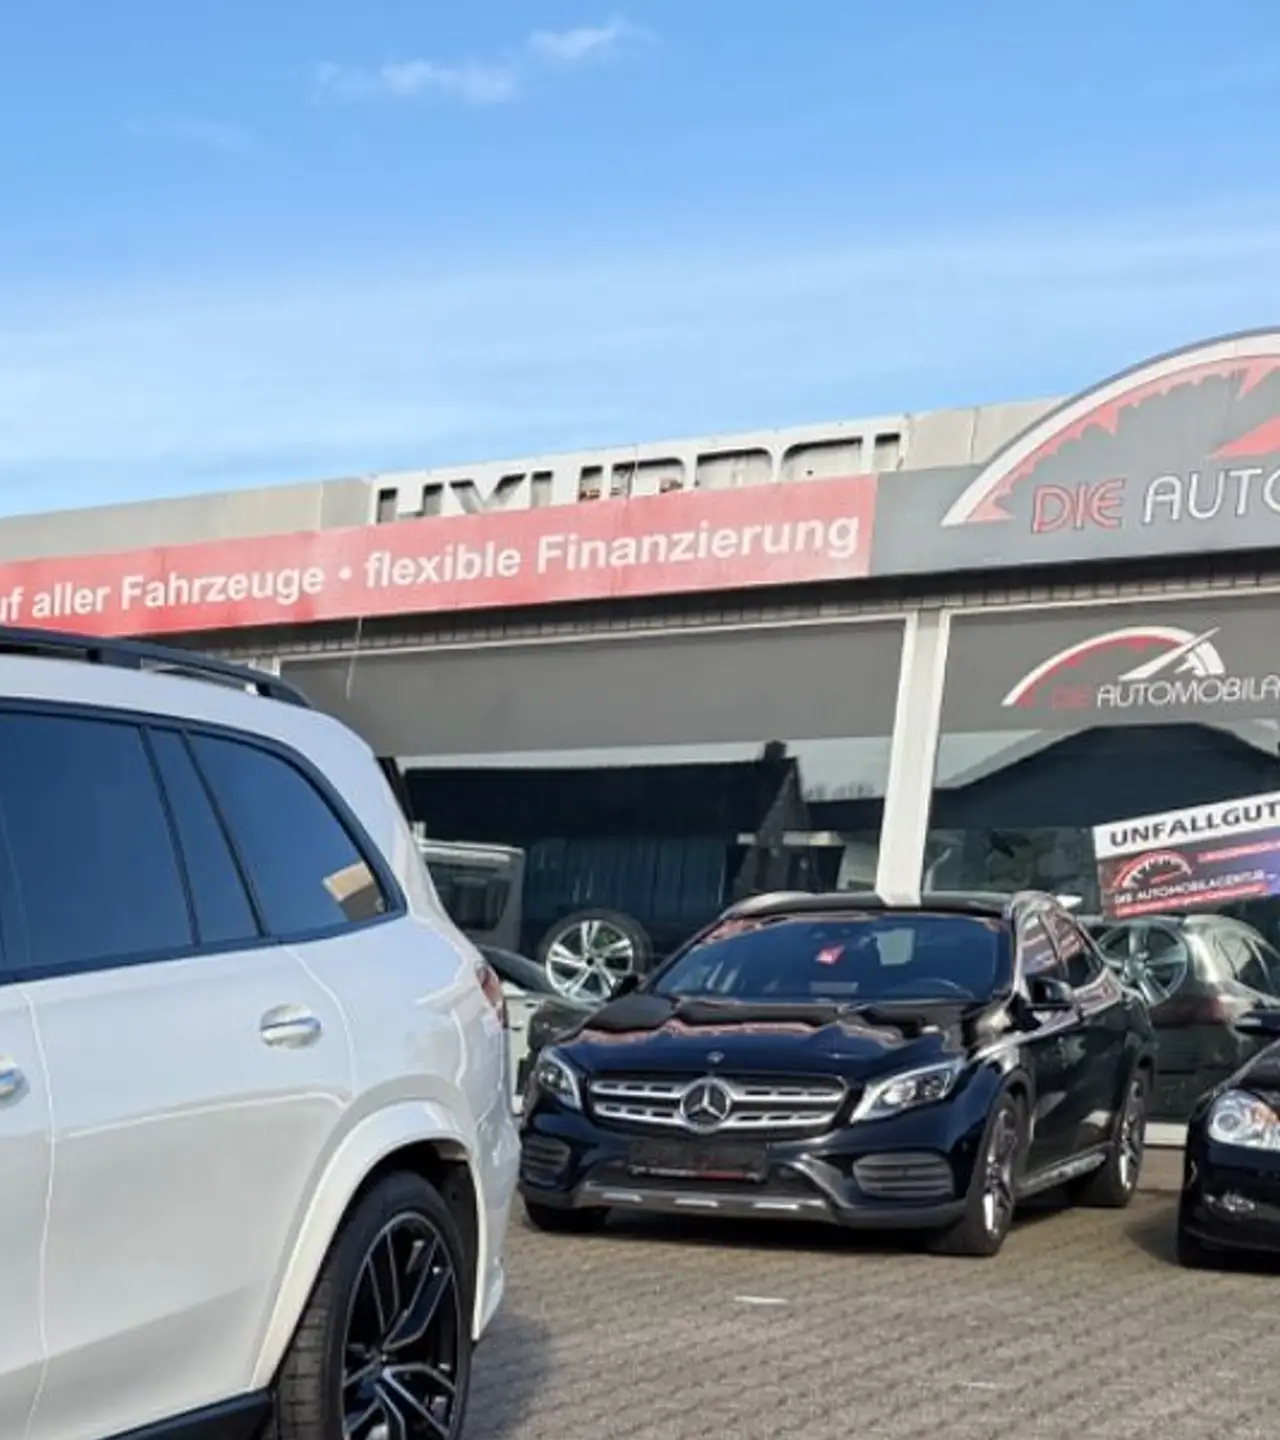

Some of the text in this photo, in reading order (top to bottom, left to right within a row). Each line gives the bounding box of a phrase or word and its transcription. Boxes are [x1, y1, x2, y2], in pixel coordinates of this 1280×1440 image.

[1031, 479, 1125, 533] DIE
[32, 581, 111, 619] aller
[121, 566, 325, 610] Fahrzeuge
[364, 541, 521, 588] flexible
[537, 515, 859, 574] Finanzierung
